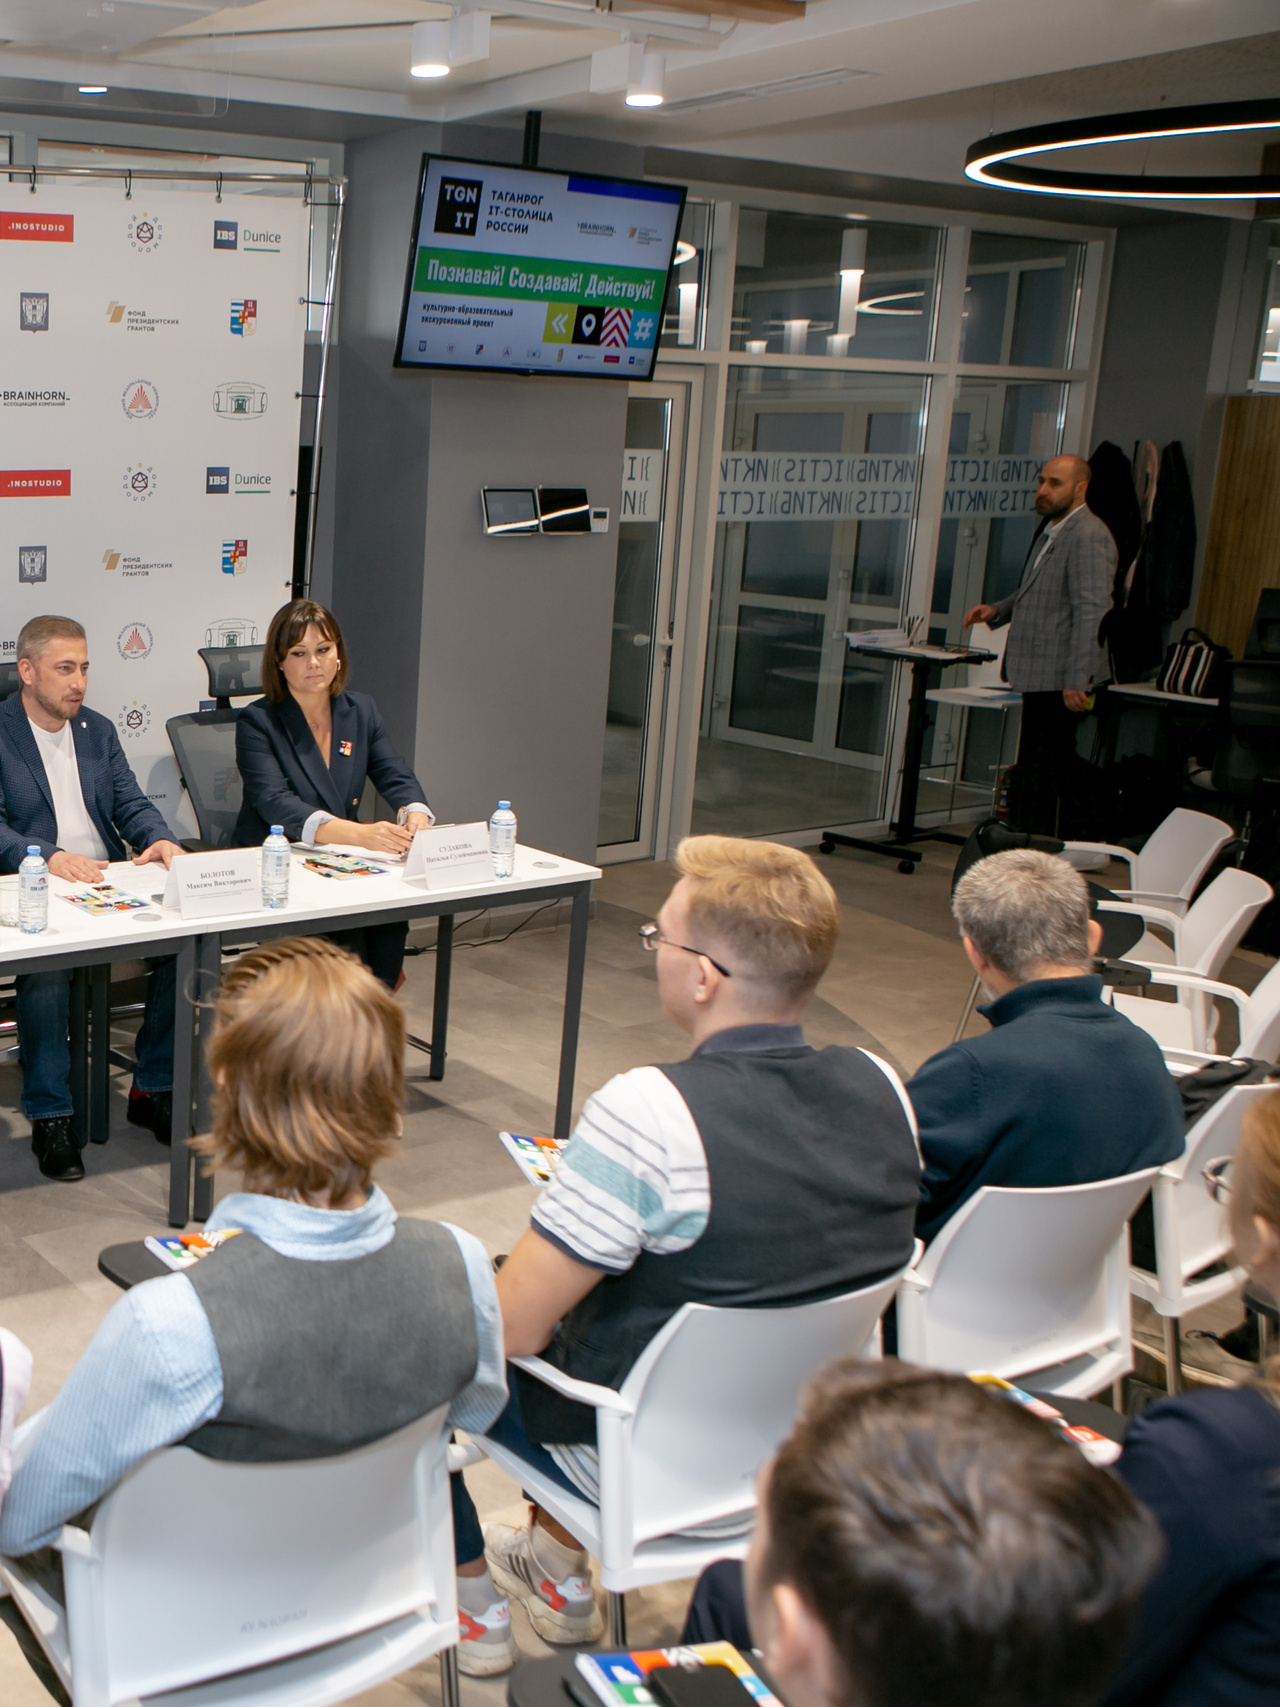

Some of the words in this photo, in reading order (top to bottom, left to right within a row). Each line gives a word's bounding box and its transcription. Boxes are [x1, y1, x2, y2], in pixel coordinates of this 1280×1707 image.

[444, 184, 478, 204] TGN
[491, 190, 544, 206] ТАГАНРОГ
[455, 212, 474, 229] IT
[488, 206, 553, 222] IT-СТОЛИЦА
[486, 221, 529, 235] РОССИИ
[216, 230, 235, 241] IBS
[243, 229, 281, 244] Dunice
[427, 259, 504, 287] Познавай!
[508, 266, 582, 294] Создавай!
[585, 278, 655, 302] Действуй!
[472, 319, 494, 329] проект
[208, 476, 228, 486] IBS
[234, 473, 272, 486] Dunice
[122, 562, 173, 570] ПРЕЗИДЕНТСКИХ
[200, 869, 236, 880] БОЛОТОВ
[186, 880, 212, 890] Максим
[214, 878, 252, 888] Викторович
